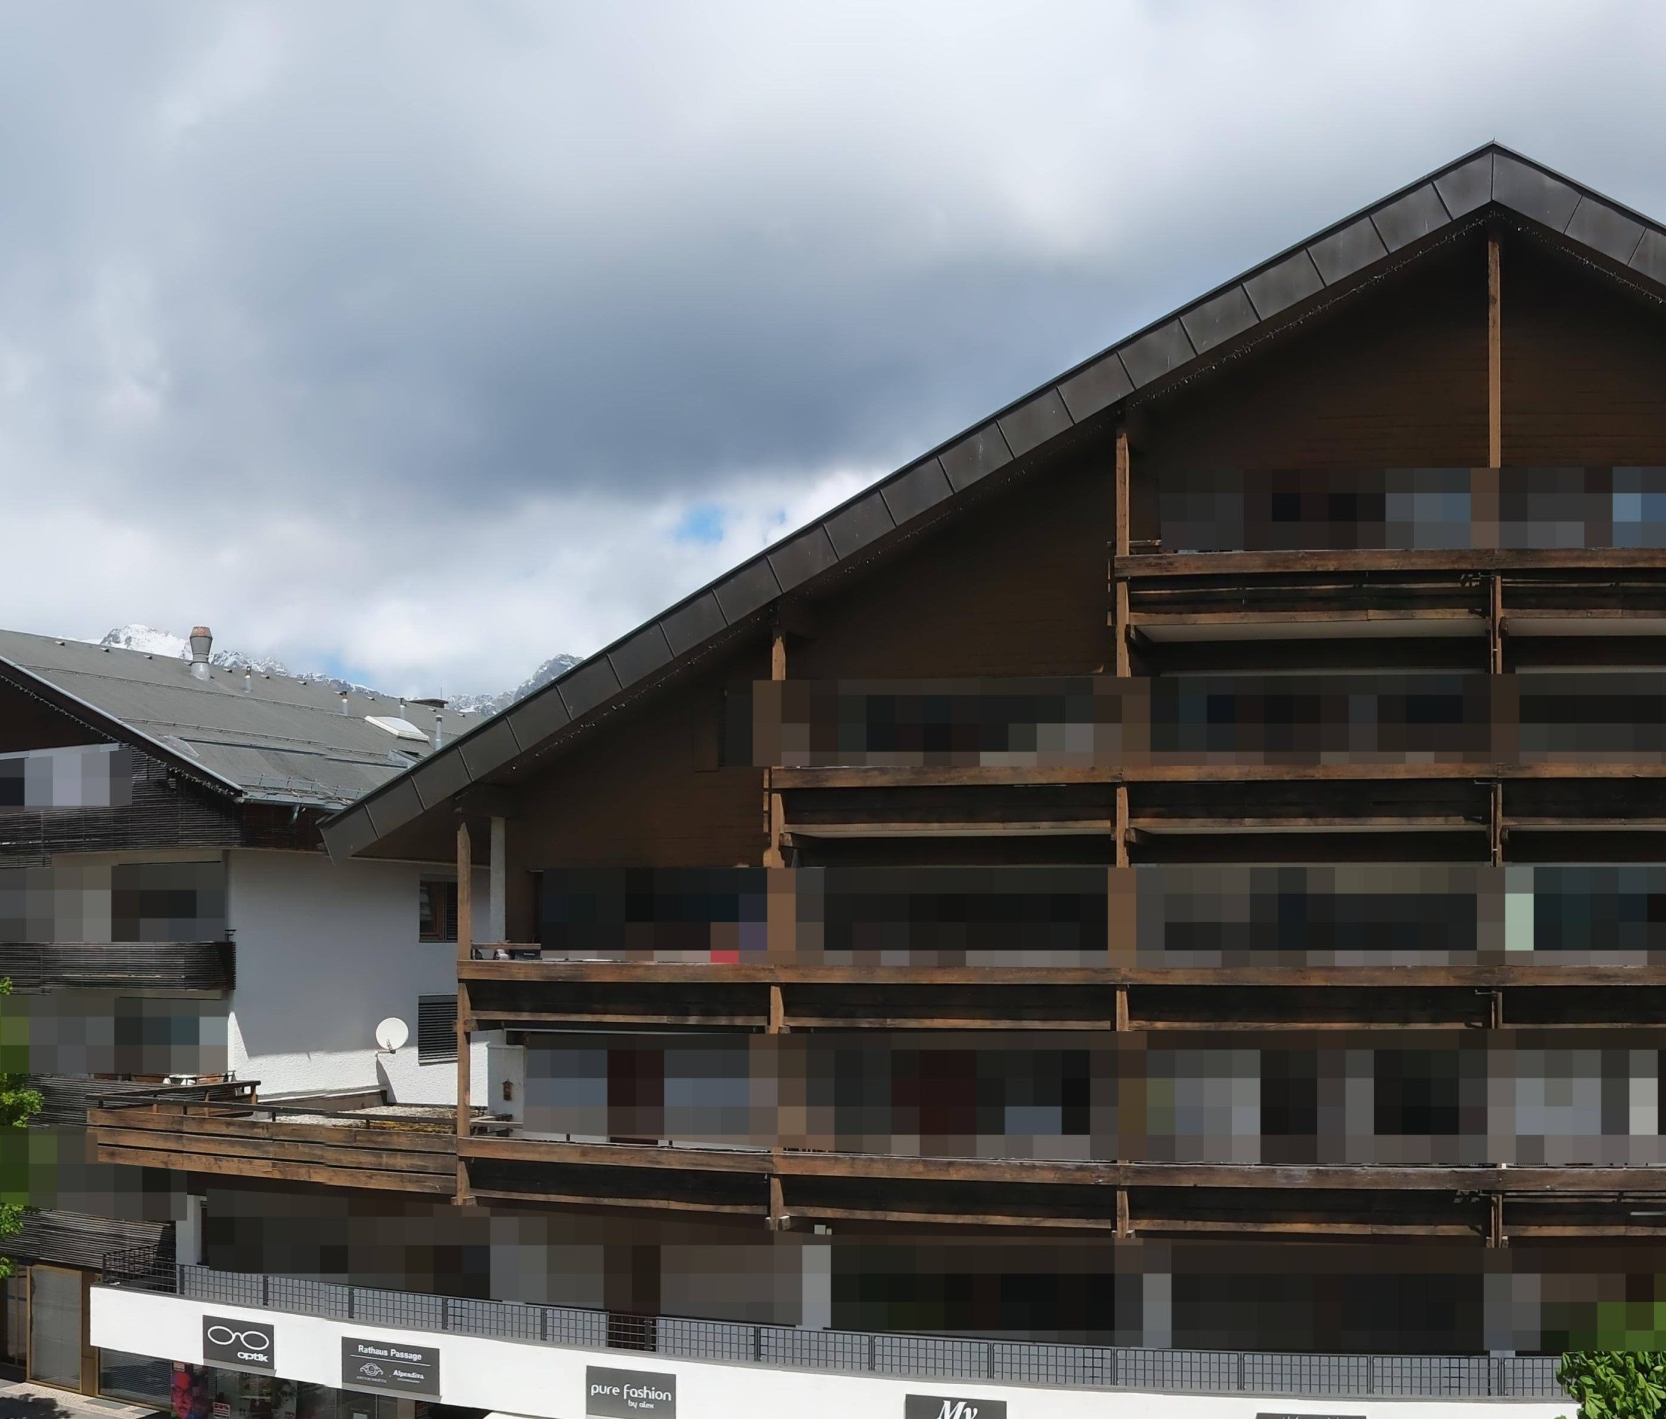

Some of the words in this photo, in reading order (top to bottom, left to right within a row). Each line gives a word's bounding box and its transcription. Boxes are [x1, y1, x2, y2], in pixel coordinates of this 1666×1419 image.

[237, 1350, 269, 1364] optik
[358, 1344, 388, 1357] Rathaus
[390, 1349, 422, 1362] Passage
[590, 1384, 620, 1396] pure
[623, 1384, 672, 1401] fashion
[628, 1399, 638, 1409] by
[639, 1401, 654, 1409] alex
